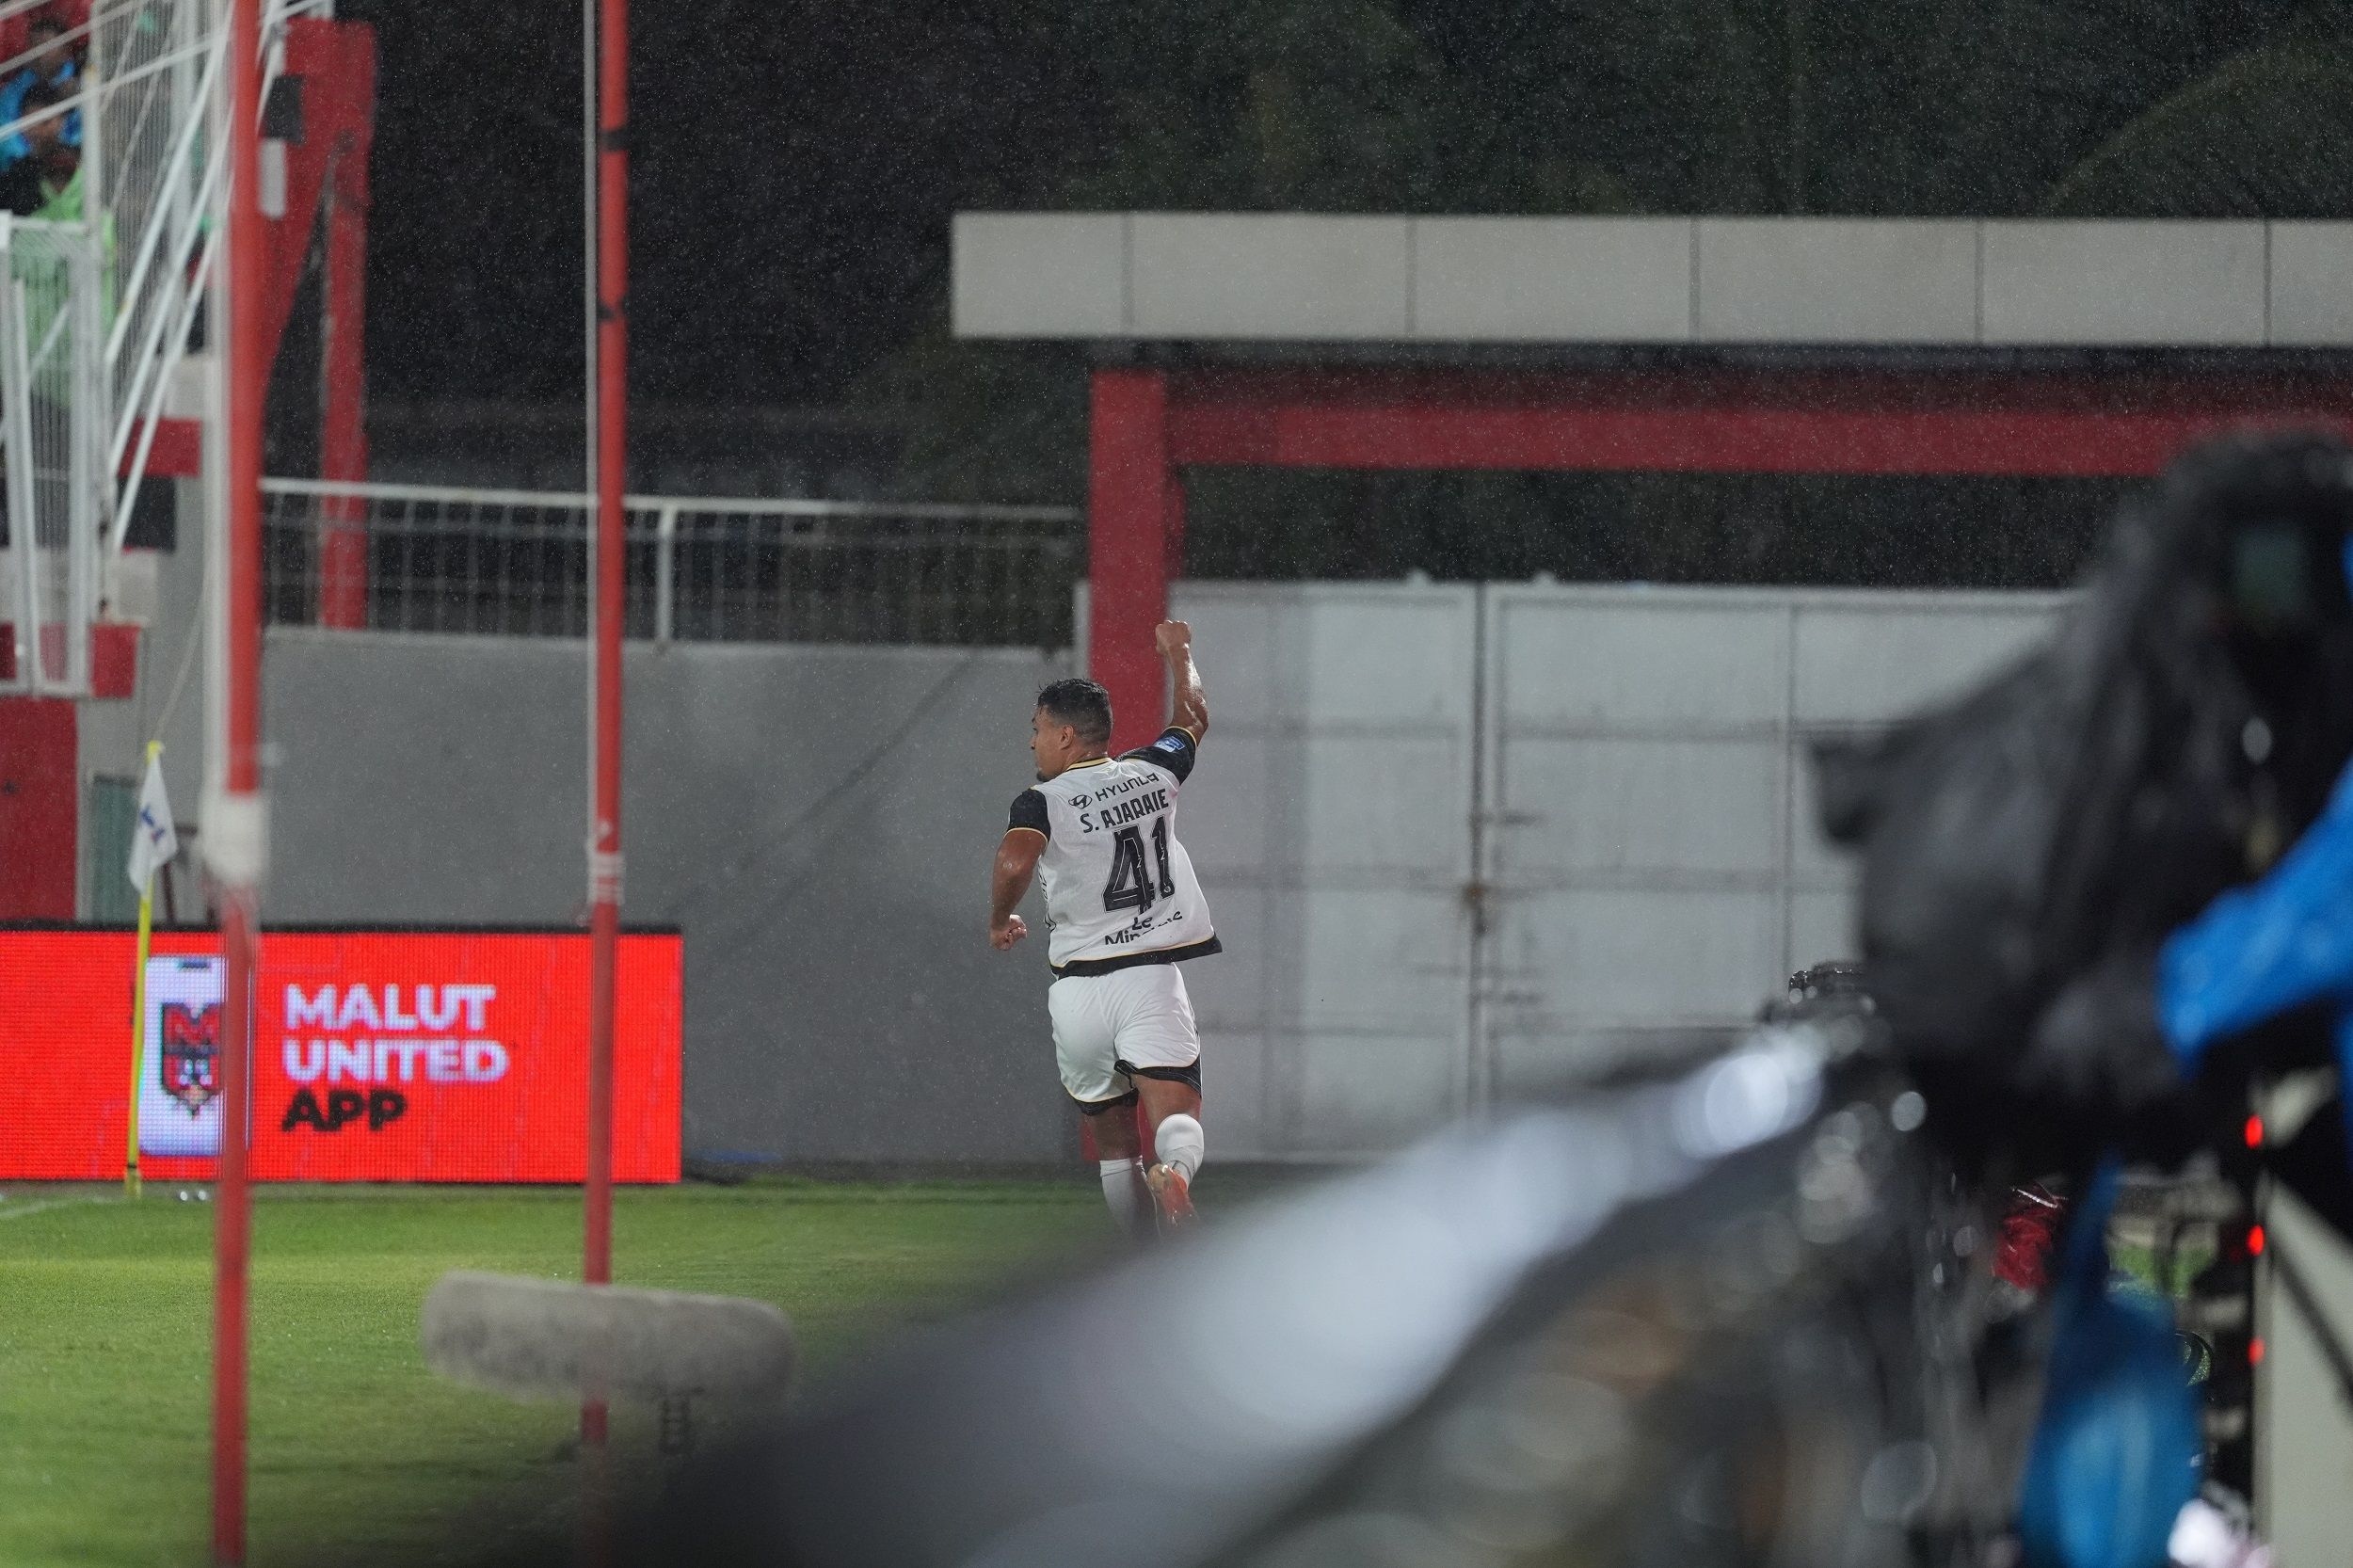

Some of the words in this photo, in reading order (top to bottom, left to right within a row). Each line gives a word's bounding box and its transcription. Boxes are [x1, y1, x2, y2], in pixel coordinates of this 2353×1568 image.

[1080, 813, 1099, 834] S.
[1100, 789, 1169, 829] AJARAIE
[1103, 815, 1176, 915] 41
[1131, 917, 1153, 931] Le
[285, 983, 497, 1032] MALUT
[283, 1039, 511, 1084] UNITED
[281, 1087, 408, 1133] APP
